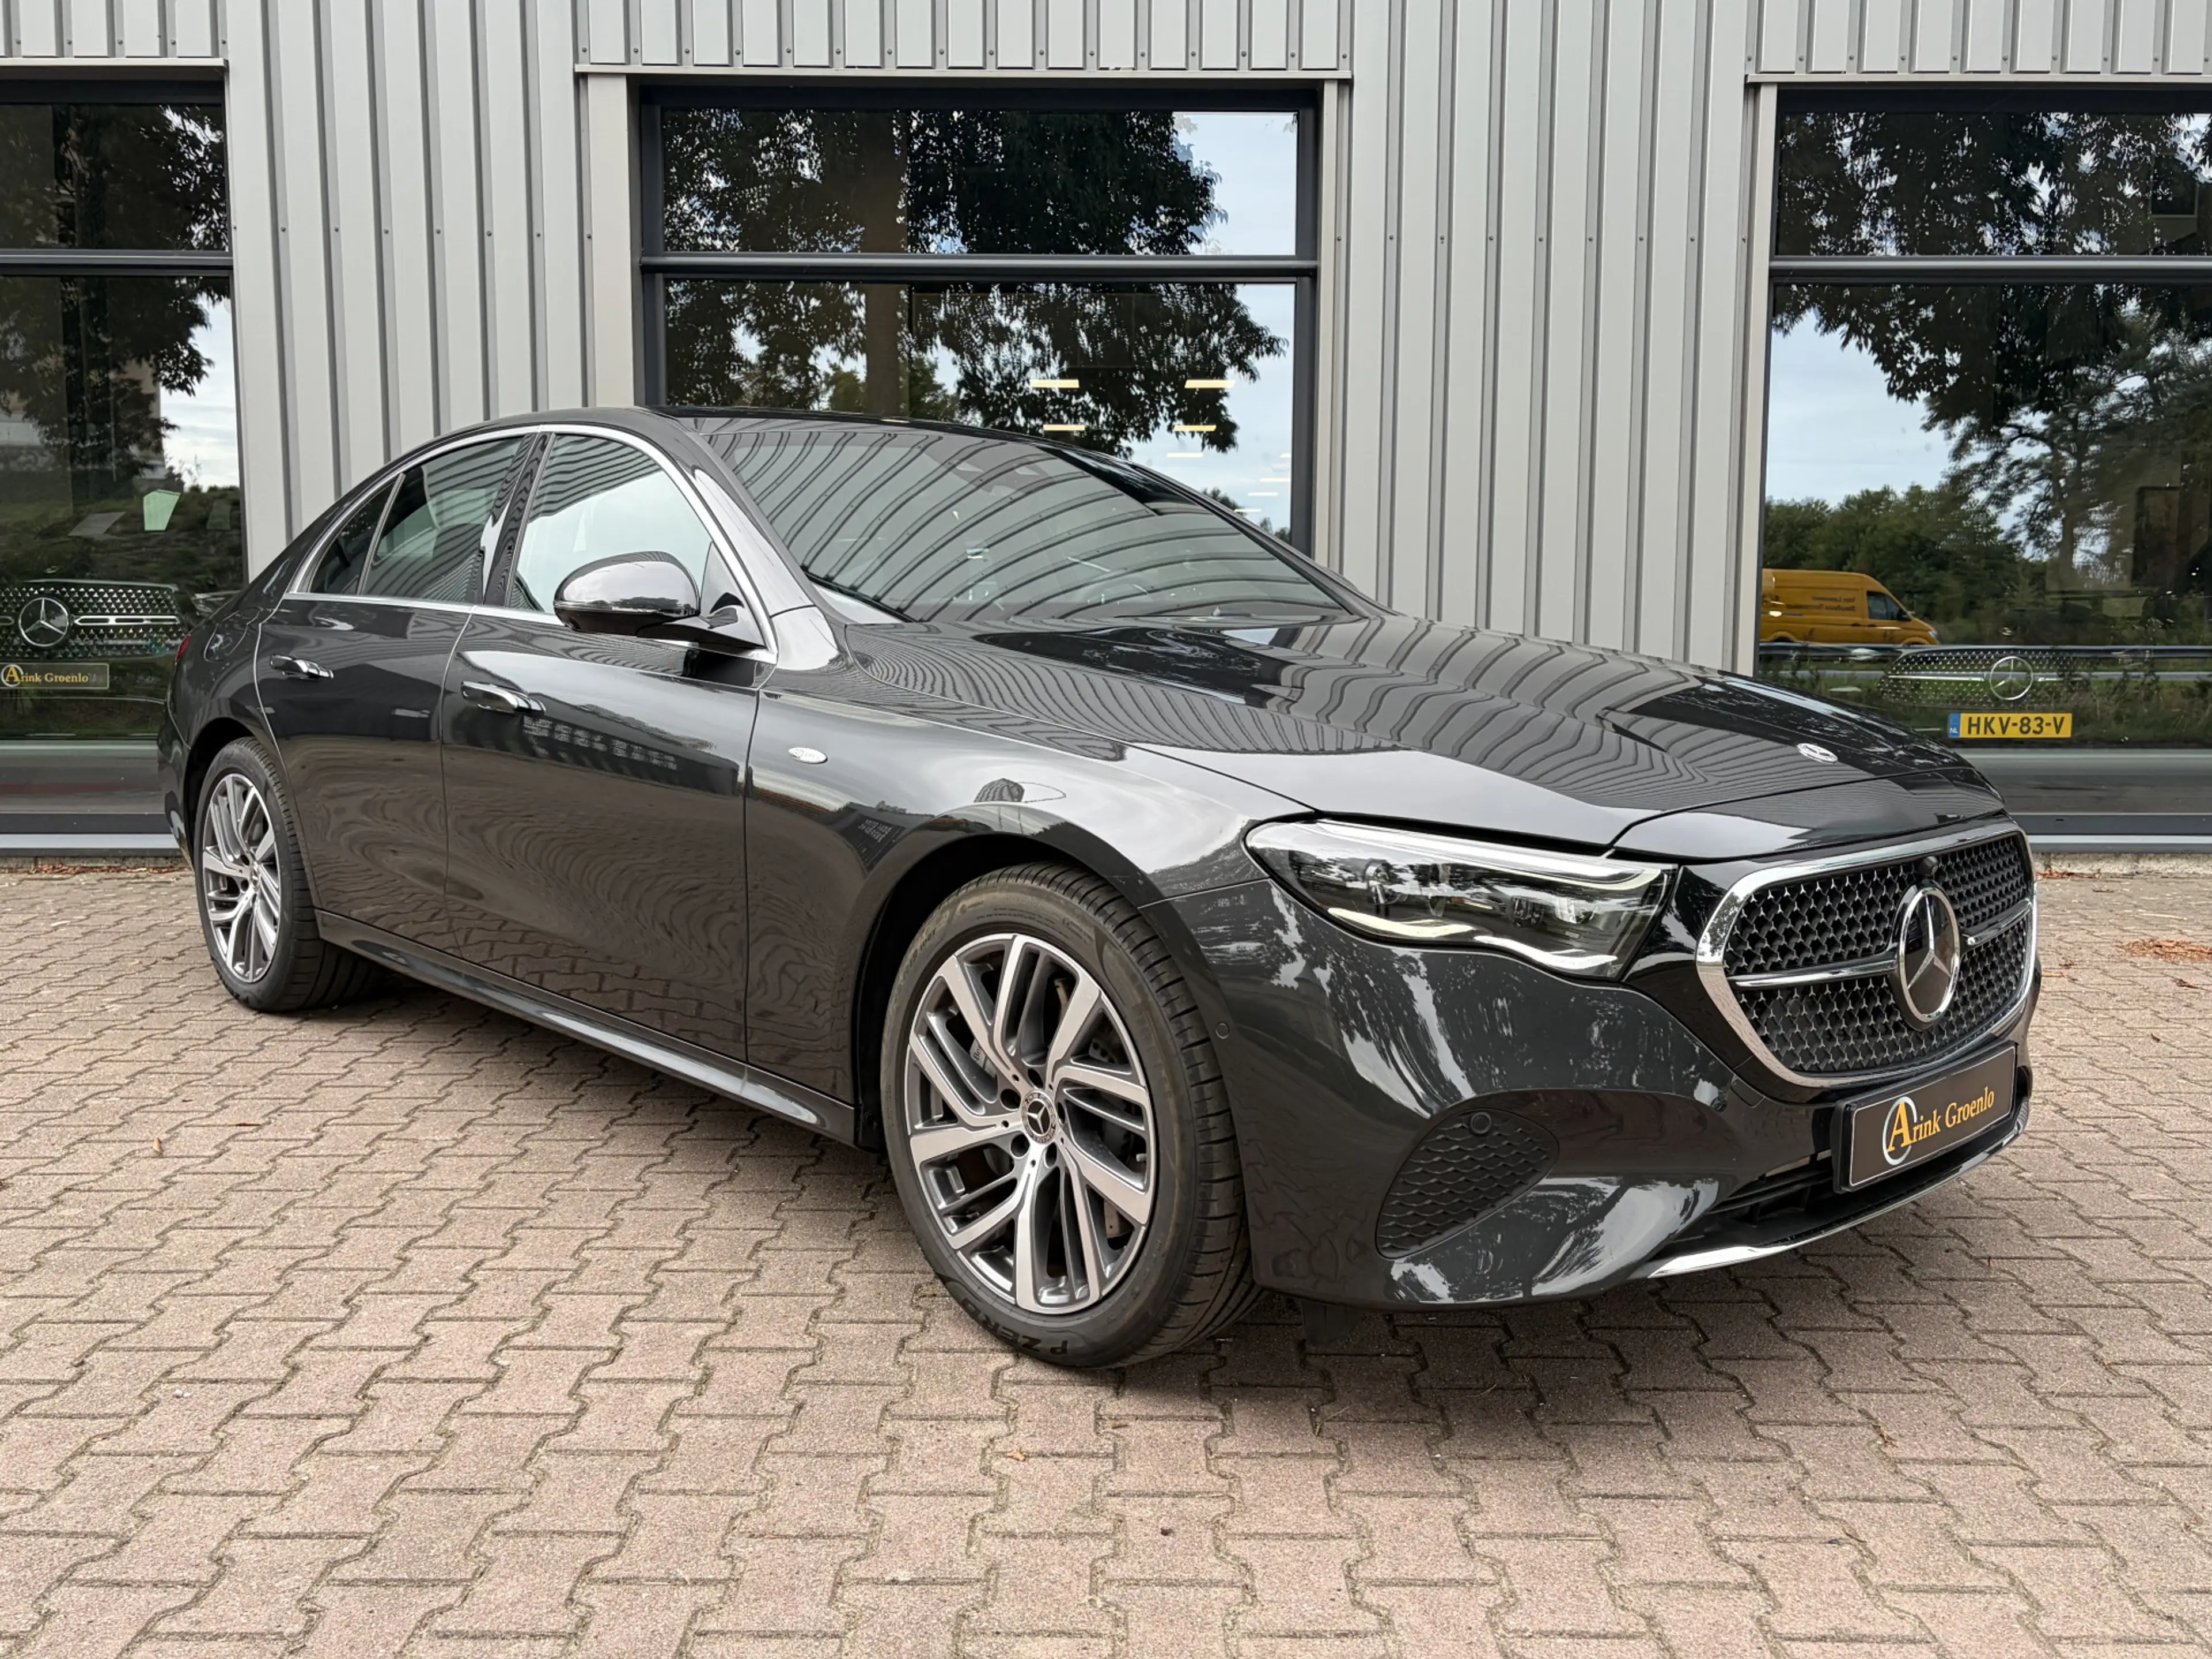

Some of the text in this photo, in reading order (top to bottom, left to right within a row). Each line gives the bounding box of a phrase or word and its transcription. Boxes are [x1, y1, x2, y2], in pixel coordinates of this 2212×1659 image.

[44, 672, 89, 683] Groenlo
[1967, 716, 2065, 735] HKV-83-V
[1888, 1086, 1995, 1152] Arink Groenlo
[961, 1297, 1069, 1355] P ZERO
